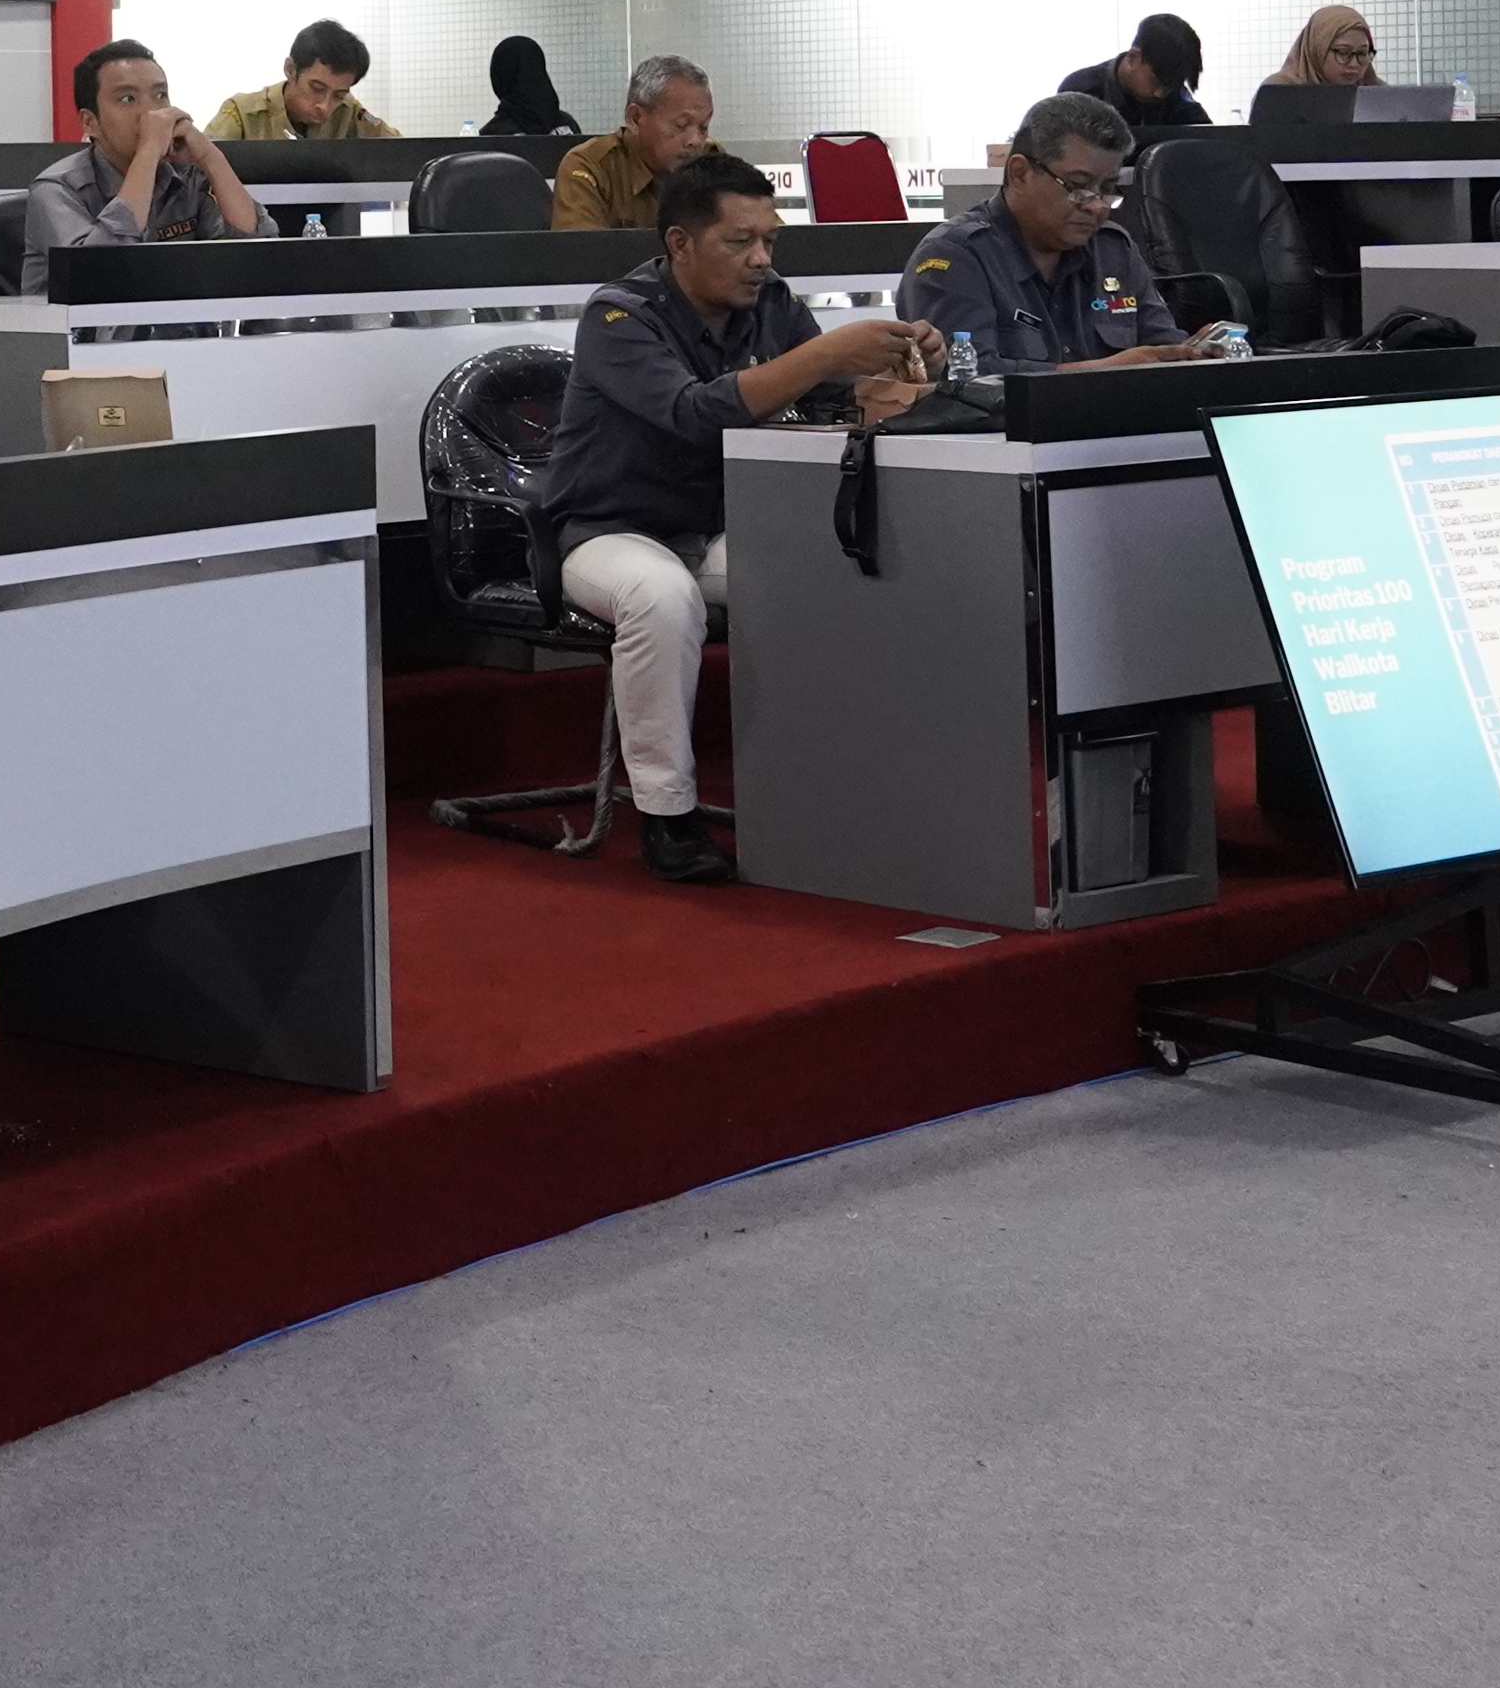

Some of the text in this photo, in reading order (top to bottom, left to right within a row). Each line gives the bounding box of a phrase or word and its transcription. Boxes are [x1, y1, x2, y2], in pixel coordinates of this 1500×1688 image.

[1281, 556, 1365, 581] Program
[1292, 579, 1412, 613] Prioritas 100
[1302, 616, 1396, 647] Hari Kerja
[1313, 651, 1400, 680] Walikota
[1324, 690, 1377, 715] Blitar
